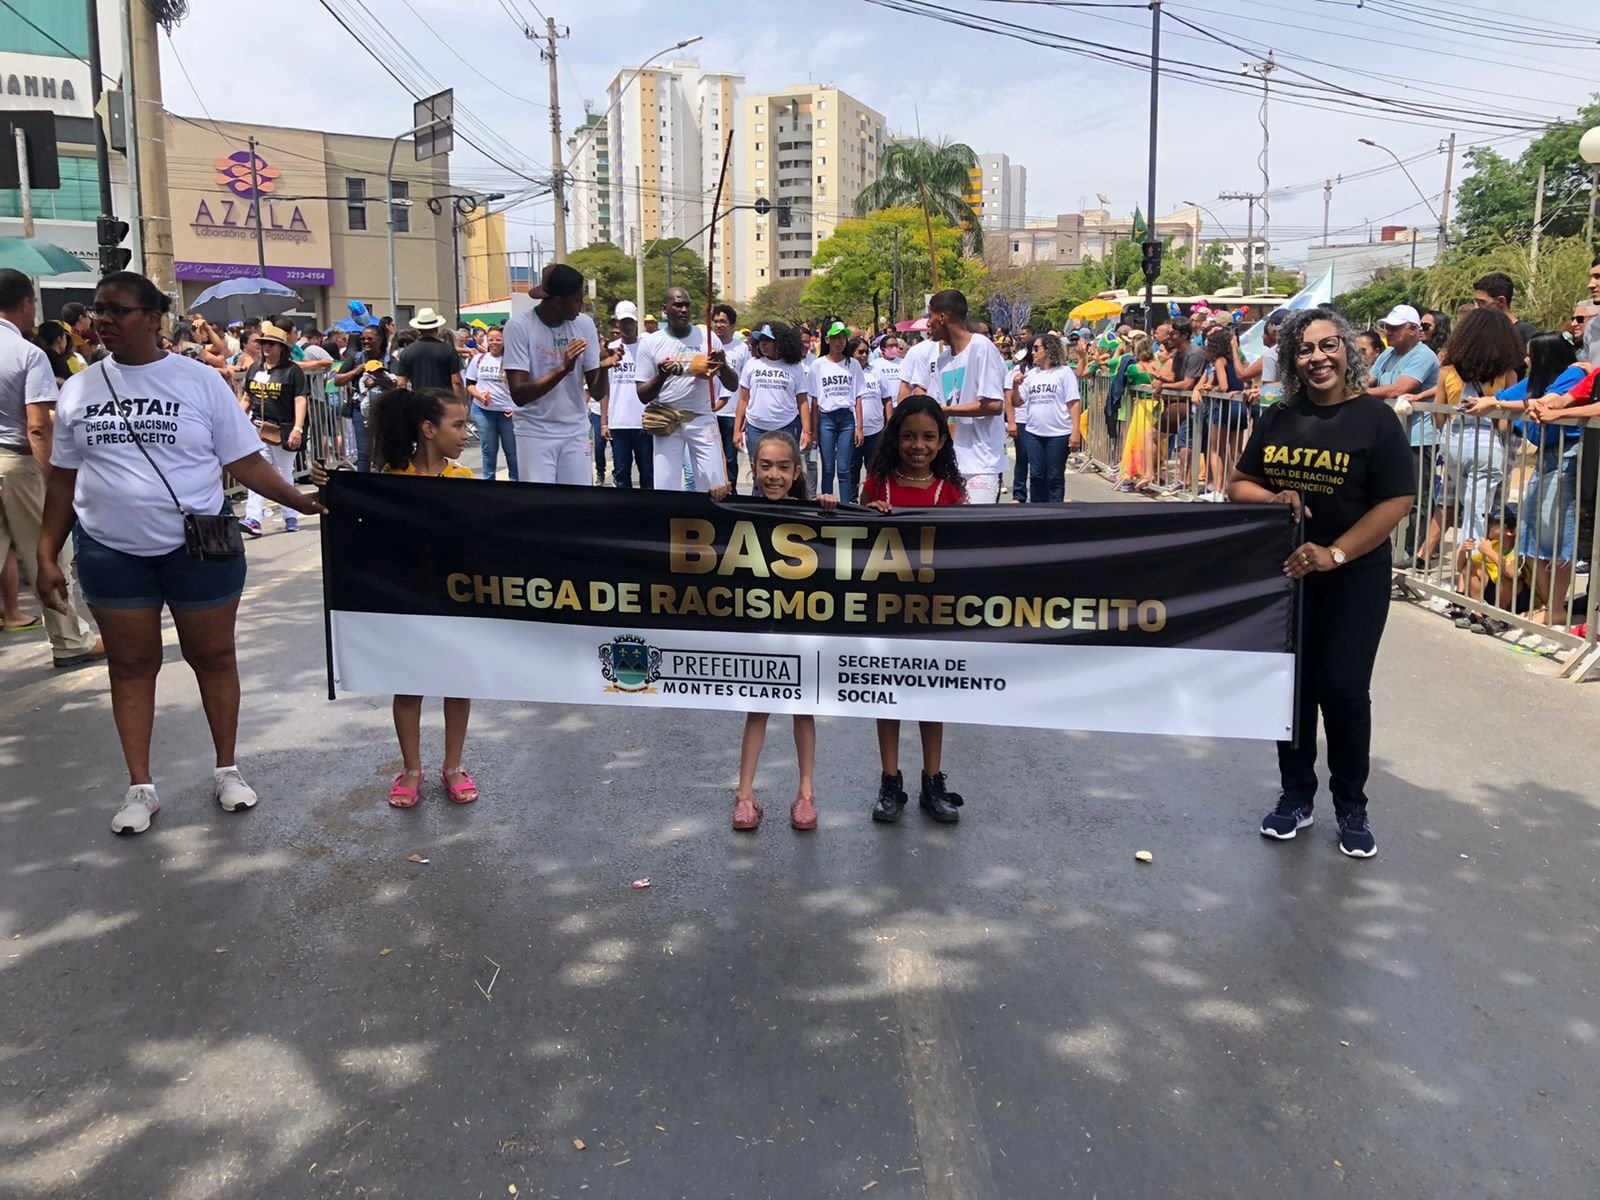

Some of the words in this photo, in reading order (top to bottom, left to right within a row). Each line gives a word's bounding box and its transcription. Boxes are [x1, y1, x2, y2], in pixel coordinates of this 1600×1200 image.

[0, 74, 75, 100] ANHA
[195, 199, 307, 229] AZALA
[195, 227, 246, 239] Laboratório
[265, 231, 308, 244] Patologia
[286, 271, 325, 280] 3213-4164
[755, 369, 790, 380] BASTA!!
[83, 398, 180, 418] BASTA!!
[85, 421, 116, 433] CHEGA
[134, 420, 178, 432] RACISMO
[86, 435, 93, 446] E
[1263, 445, 1350, 473] BASTA!!
[1288, 470, 1301, 478] DE
[669, 517, 937, 583] BASTA!
[446, 572, 583, 611] CHEGA
[589, 580, 642, 613] DE
[650, 583, 835, 621] RACISMO
[844, 592, 868, 622] E
[876, 593, 1168, 633] PRECONCEITO
[672, 655, 792, 681] PREFEITURA
[838, 655, 939, 671] SECRETARIA
[945, 659, 967, 672] DE
[837, 672, 1007, 691] DESENVOLVIMENTO
[663, 682, 733, 697] MONTES
[738, 685, 802, 700] CLAROS
[837, 689, 898, 705] SOCIAL
